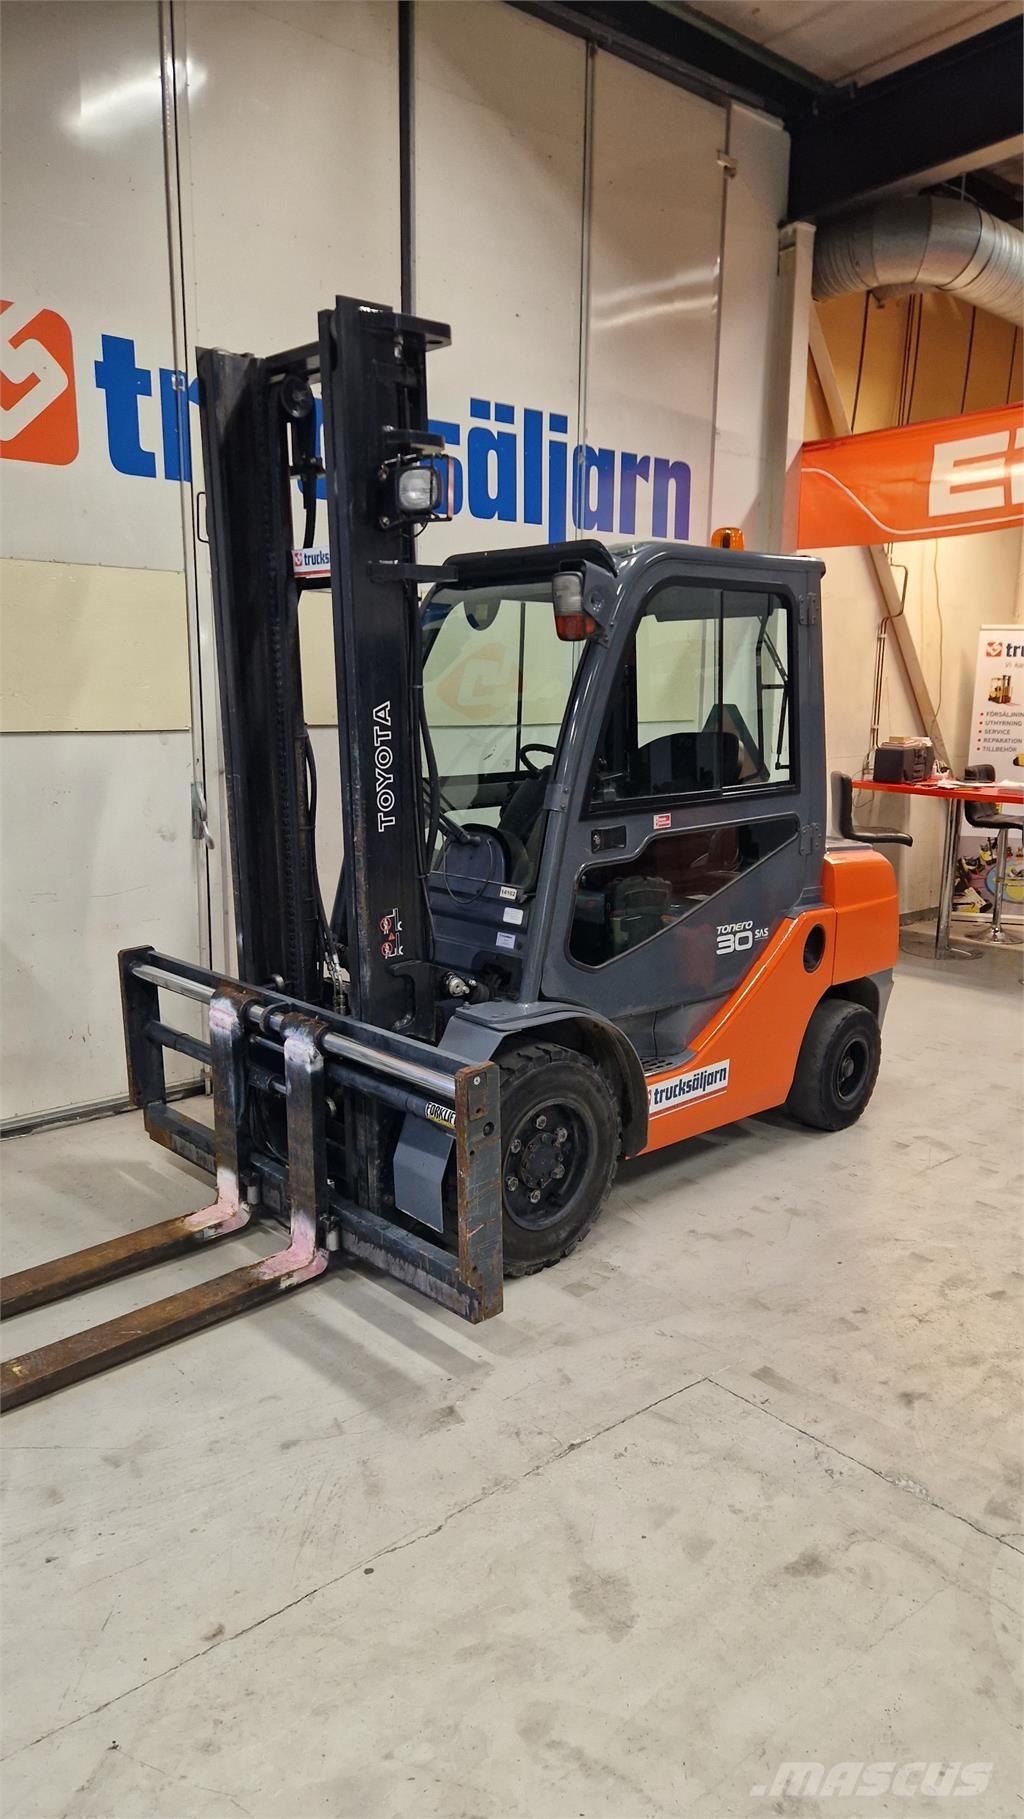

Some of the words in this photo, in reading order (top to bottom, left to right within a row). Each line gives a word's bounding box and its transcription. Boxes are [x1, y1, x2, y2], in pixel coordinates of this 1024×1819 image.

[928, 427, 1024, 517] E
[373, 701, 396, 832] TOYOTA
[716, 930, 753, 955] 30
[754, 928, 769, 938] SAS
[653, 1067, 727, 1105] trucksäljarn
